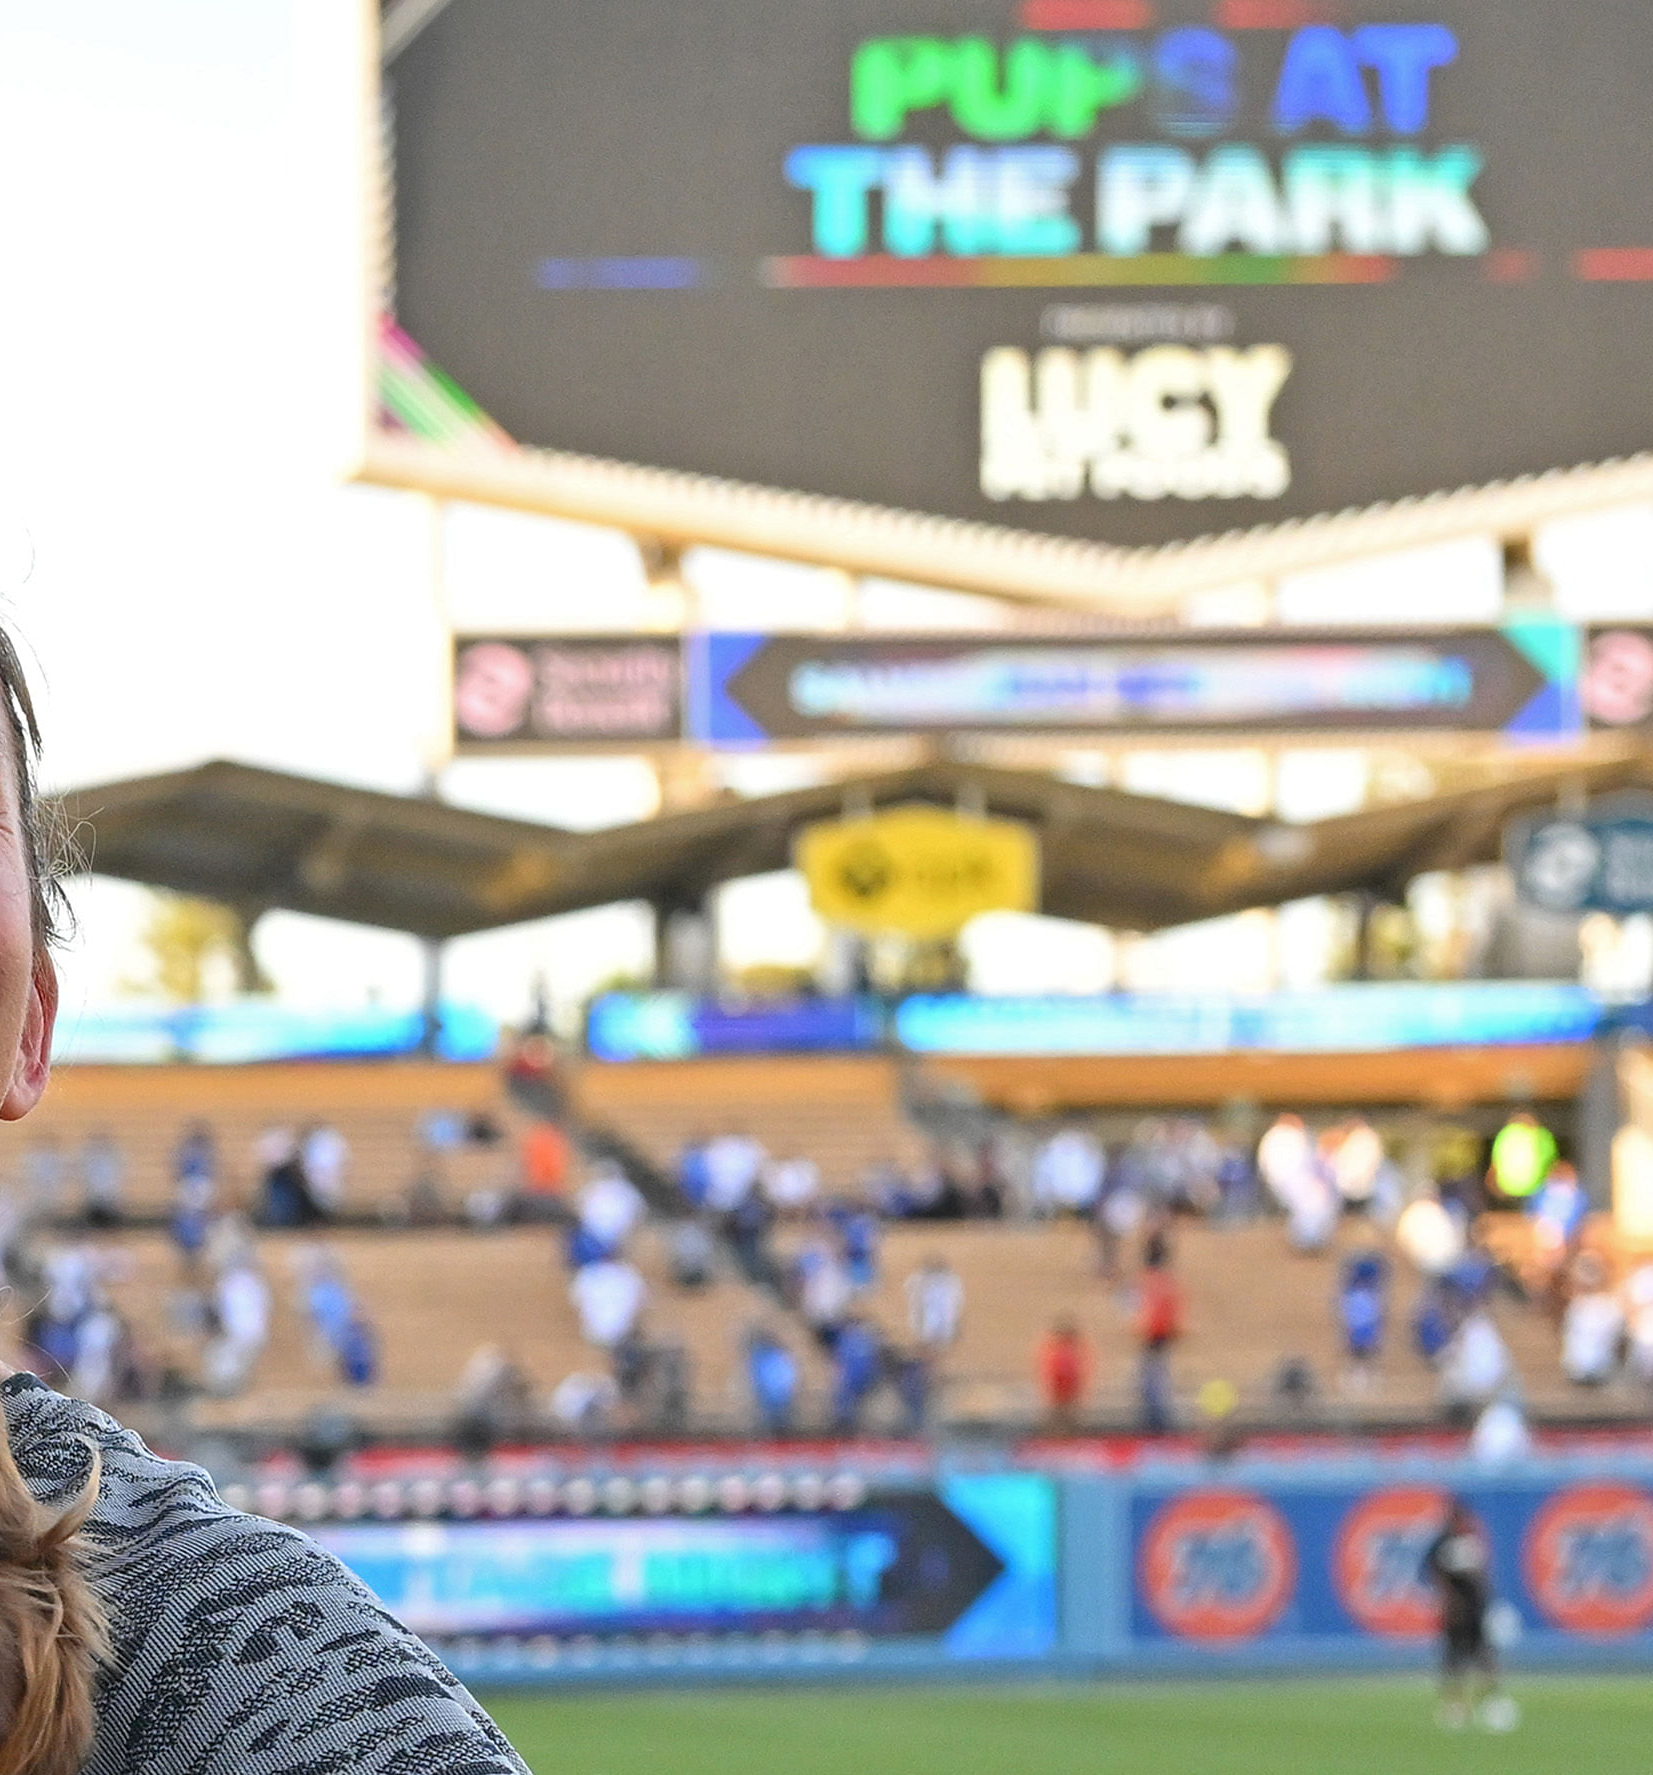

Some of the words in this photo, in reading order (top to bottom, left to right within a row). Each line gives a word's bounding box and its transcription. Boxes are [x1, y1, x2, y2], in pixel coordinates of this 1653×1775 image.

[850, 27, 1240, 138] PUPS
[1270, 24, 1458, 134] AT
[784, 144, 1082, 257] THE
[1097, 143, 1490, 256] PARK
